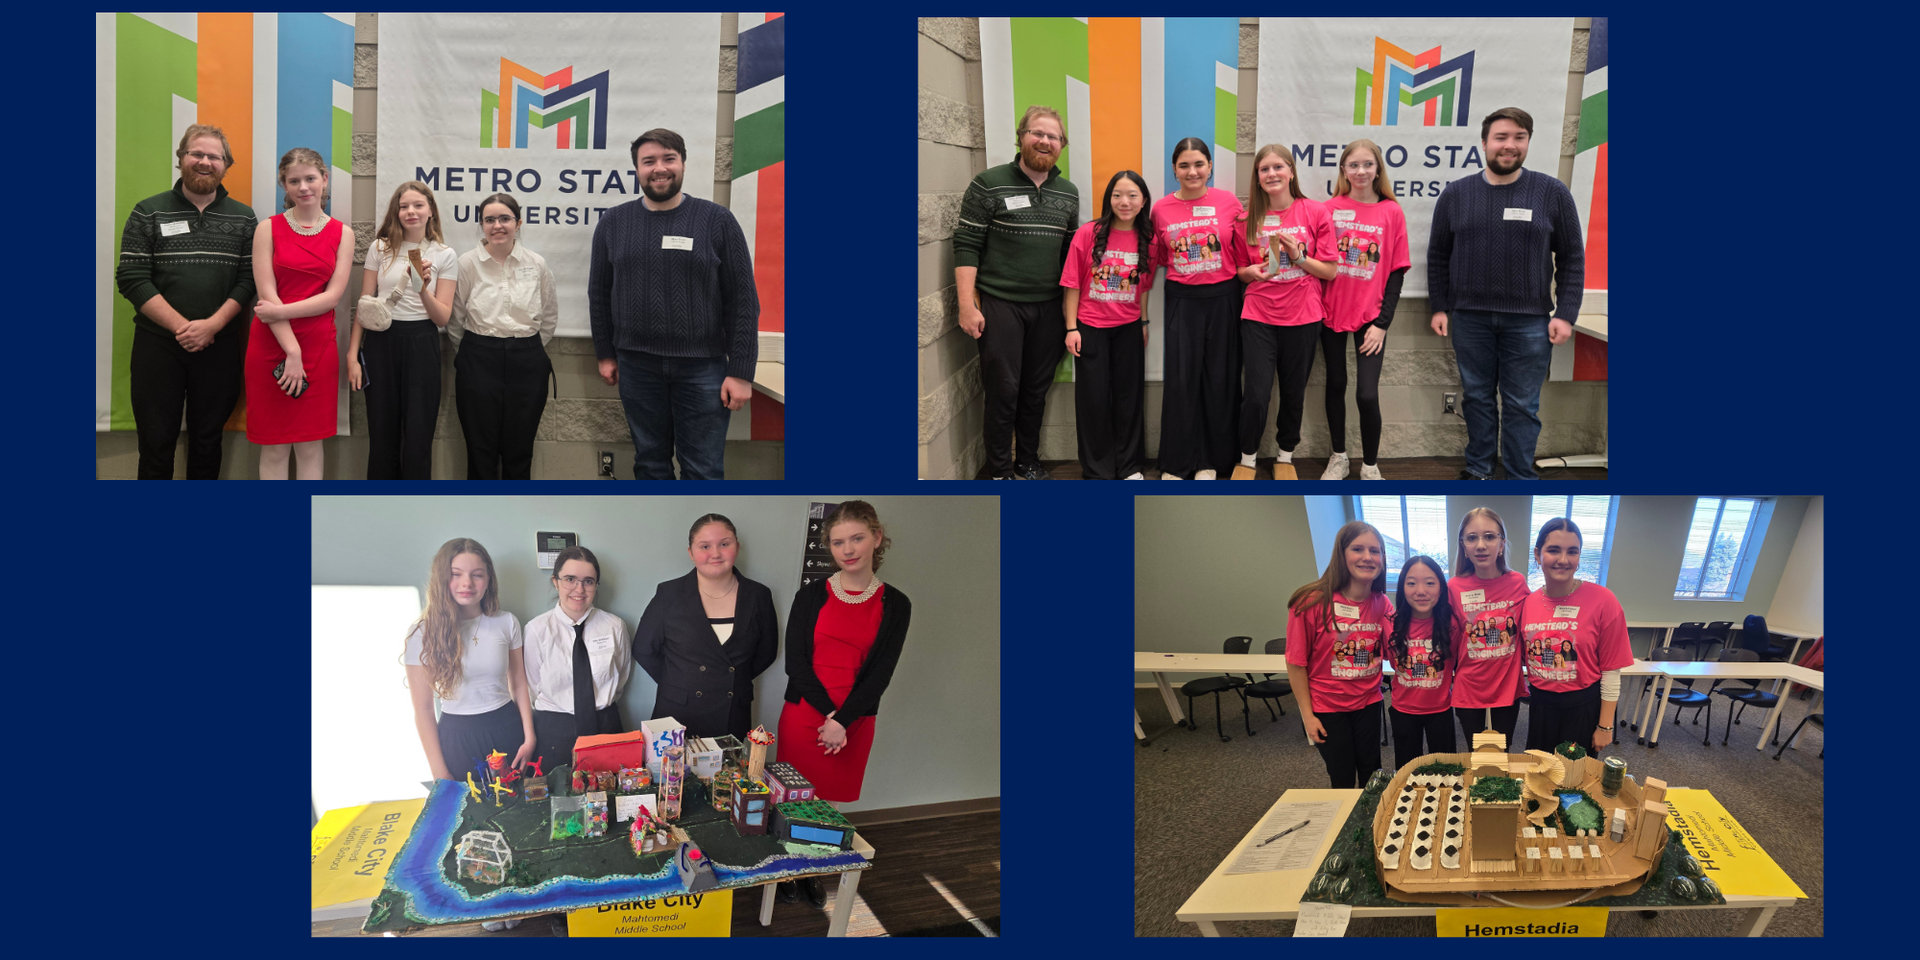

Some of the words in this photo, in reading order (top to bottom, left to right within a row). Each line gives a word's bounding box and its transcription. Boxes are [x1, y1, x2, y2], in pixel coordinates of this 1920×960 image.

[1293, 144, 1408, 168] MEO
[416, 167, 542, 193] METRO
[558, 169, 641, 195] STAT
[1167, 217, 1219, 232] HEMSTEAD'S
[1525, 621, 1578, 631] HEMSTEAD'S
[373, 812, 401, 845] Blake
[1663, 800, 1721, 871] Hemstadia
[354, 848, 386, 876] City
[597, 899, 656, 914] Blake
[663, 894, 704, 909] City
[622, 912, 679, 924] Mahtomedi
[614, 925, 649, 935] Middle
[651, 922, 686, 934] School
[1465, 922, 1579, 937] Hemstadia
